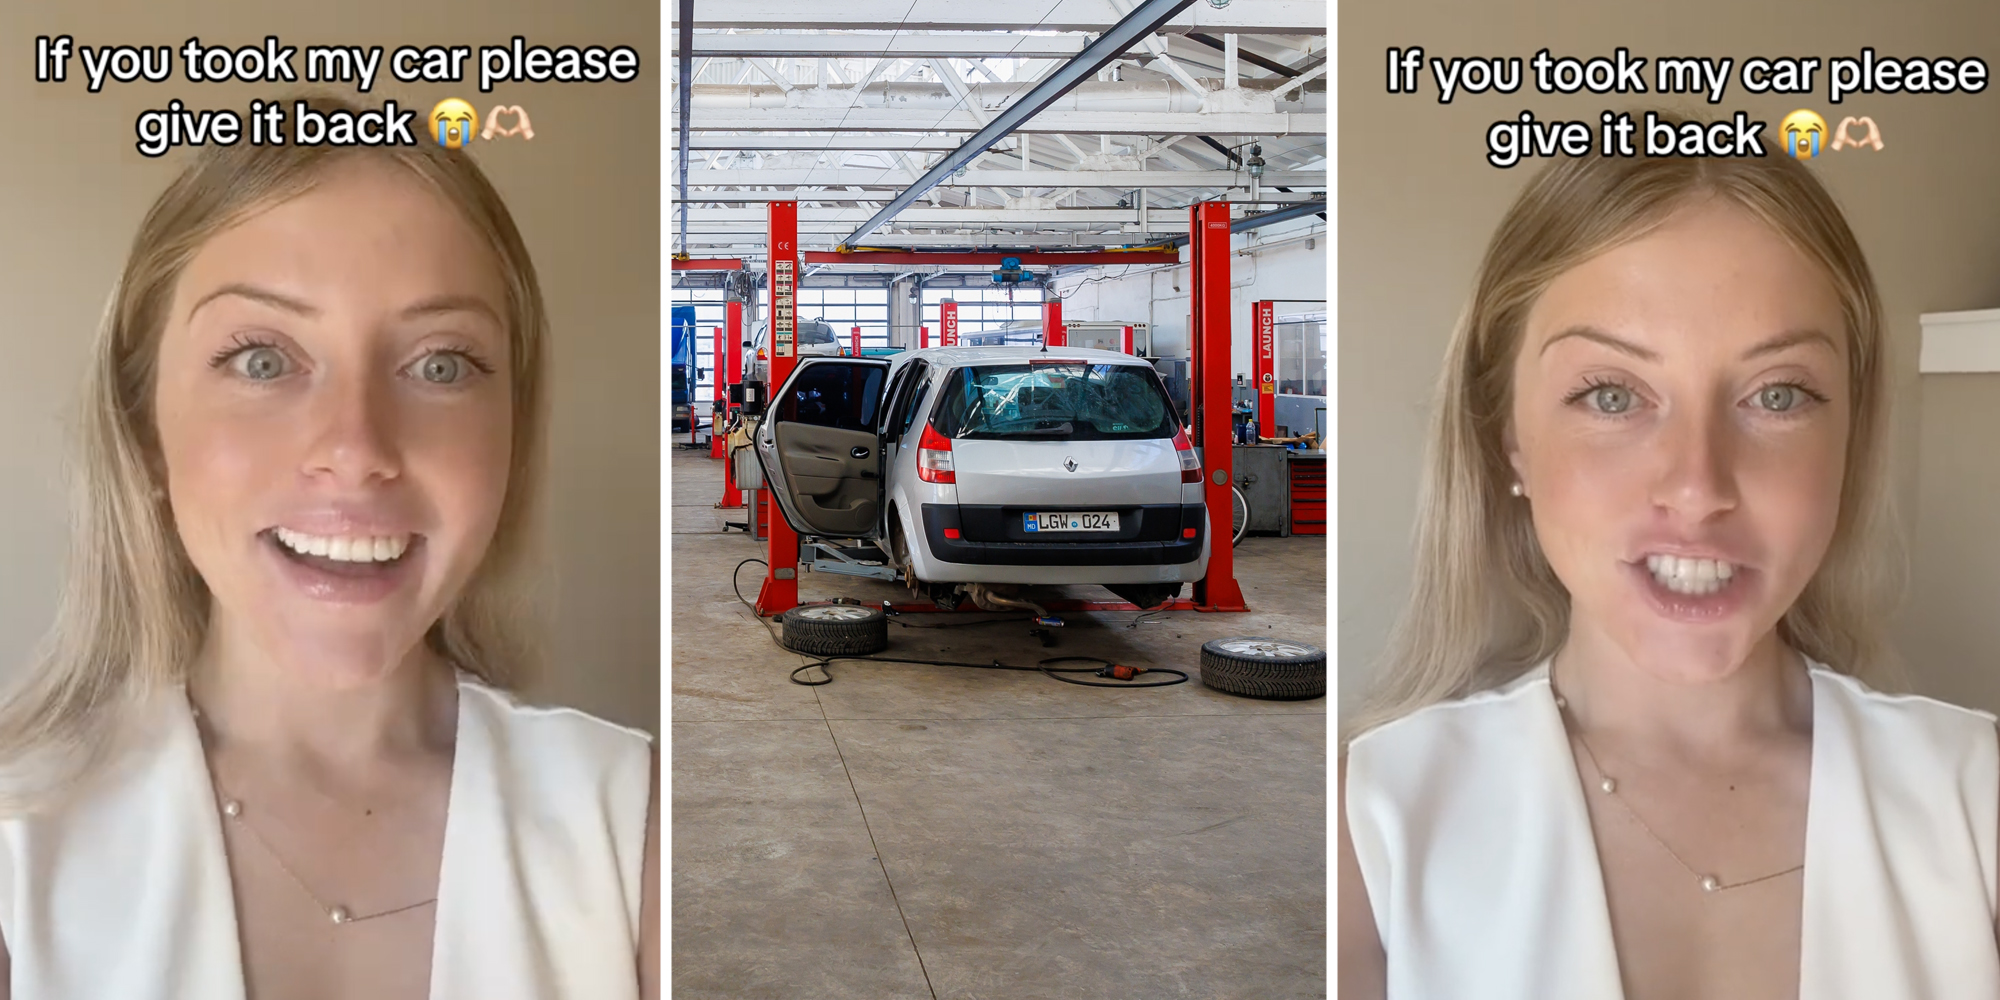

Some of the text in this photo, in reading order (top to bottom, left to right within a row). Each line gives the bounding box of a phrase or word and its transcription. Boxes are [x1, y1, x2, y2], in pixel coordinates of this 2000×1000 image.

[778, 241, 789, 250] CE
[1262, 308, 1272, 359] LAUNCH
[1039, 514, 1111, 529] LGW 024
